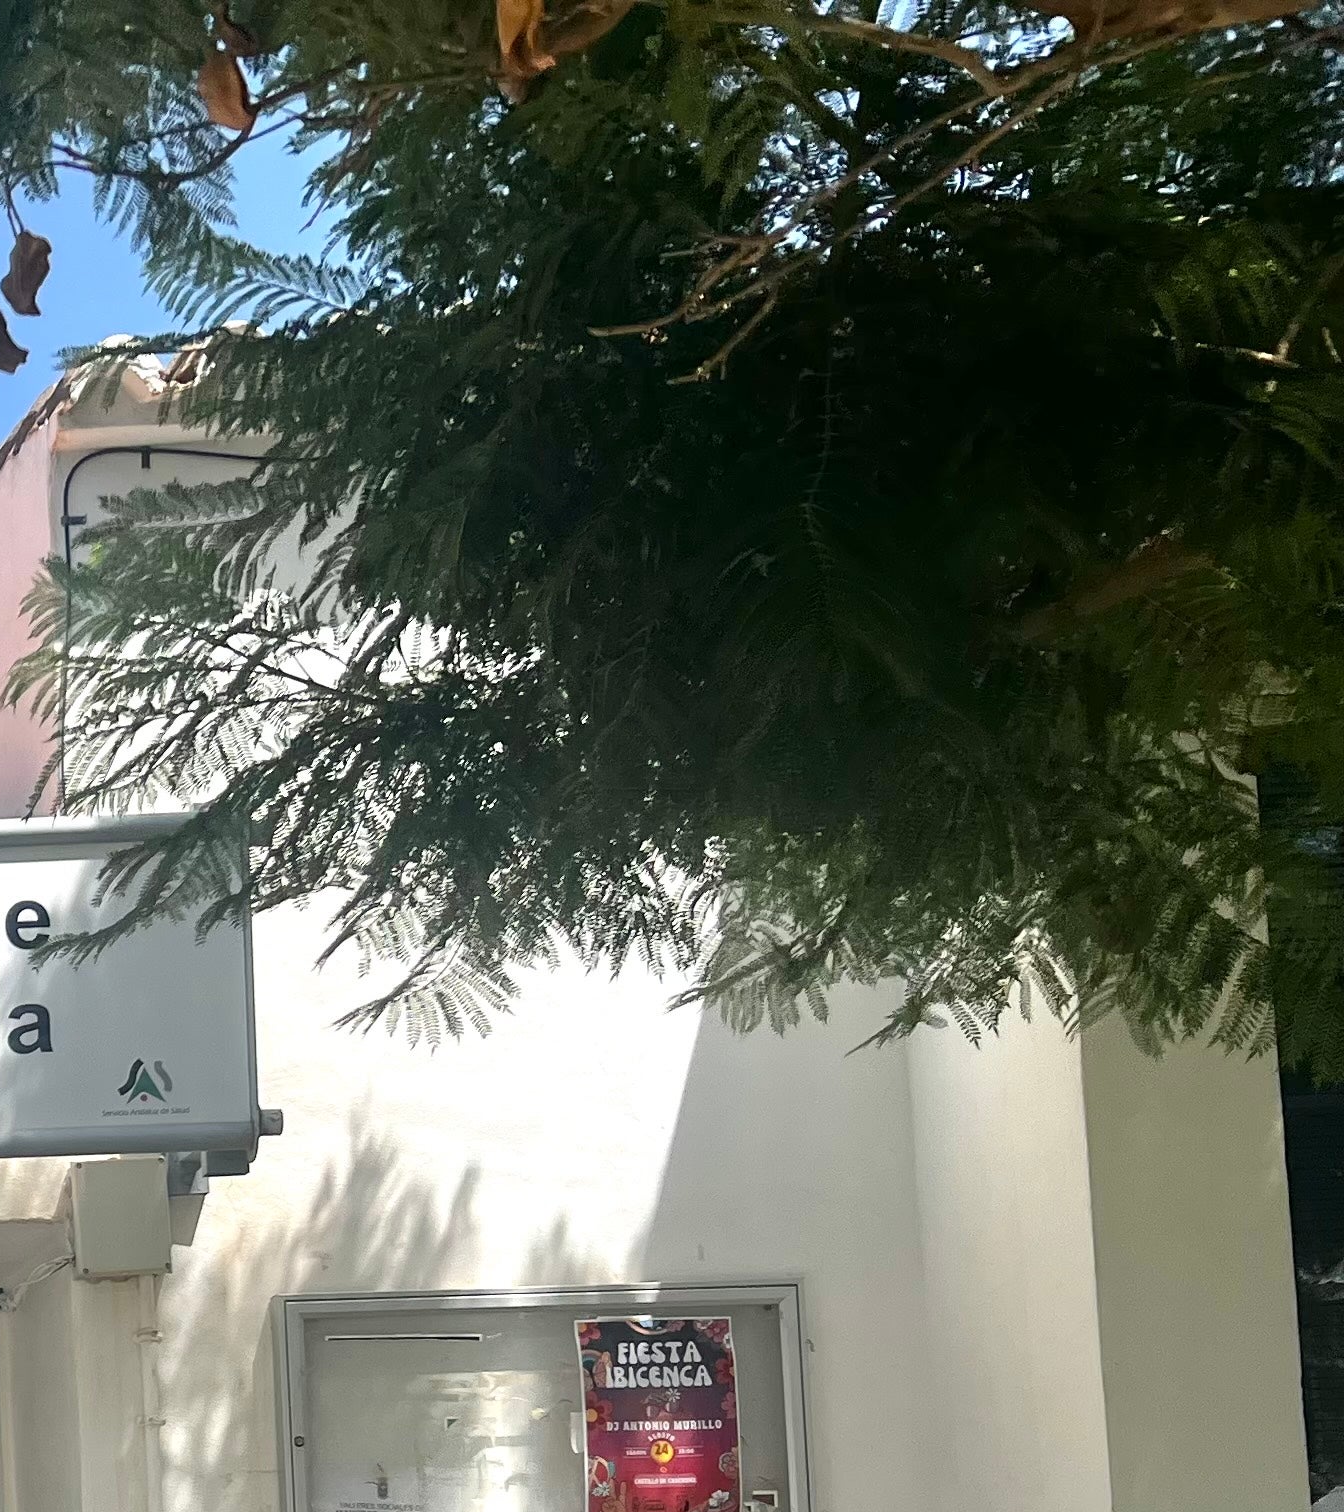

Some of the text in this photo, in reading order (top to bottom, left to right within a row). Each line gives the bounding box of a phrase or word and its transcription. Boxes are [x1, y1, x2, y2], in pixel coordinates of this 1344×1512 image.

[617, 1341, 702, 1364] FIESTA
[605, 1364, 713, 1388] IBICENCA
[606, 1419, 723, 1431] DJ ANTONIO MURILLO
[655, 1443, 669, 1455] 24
